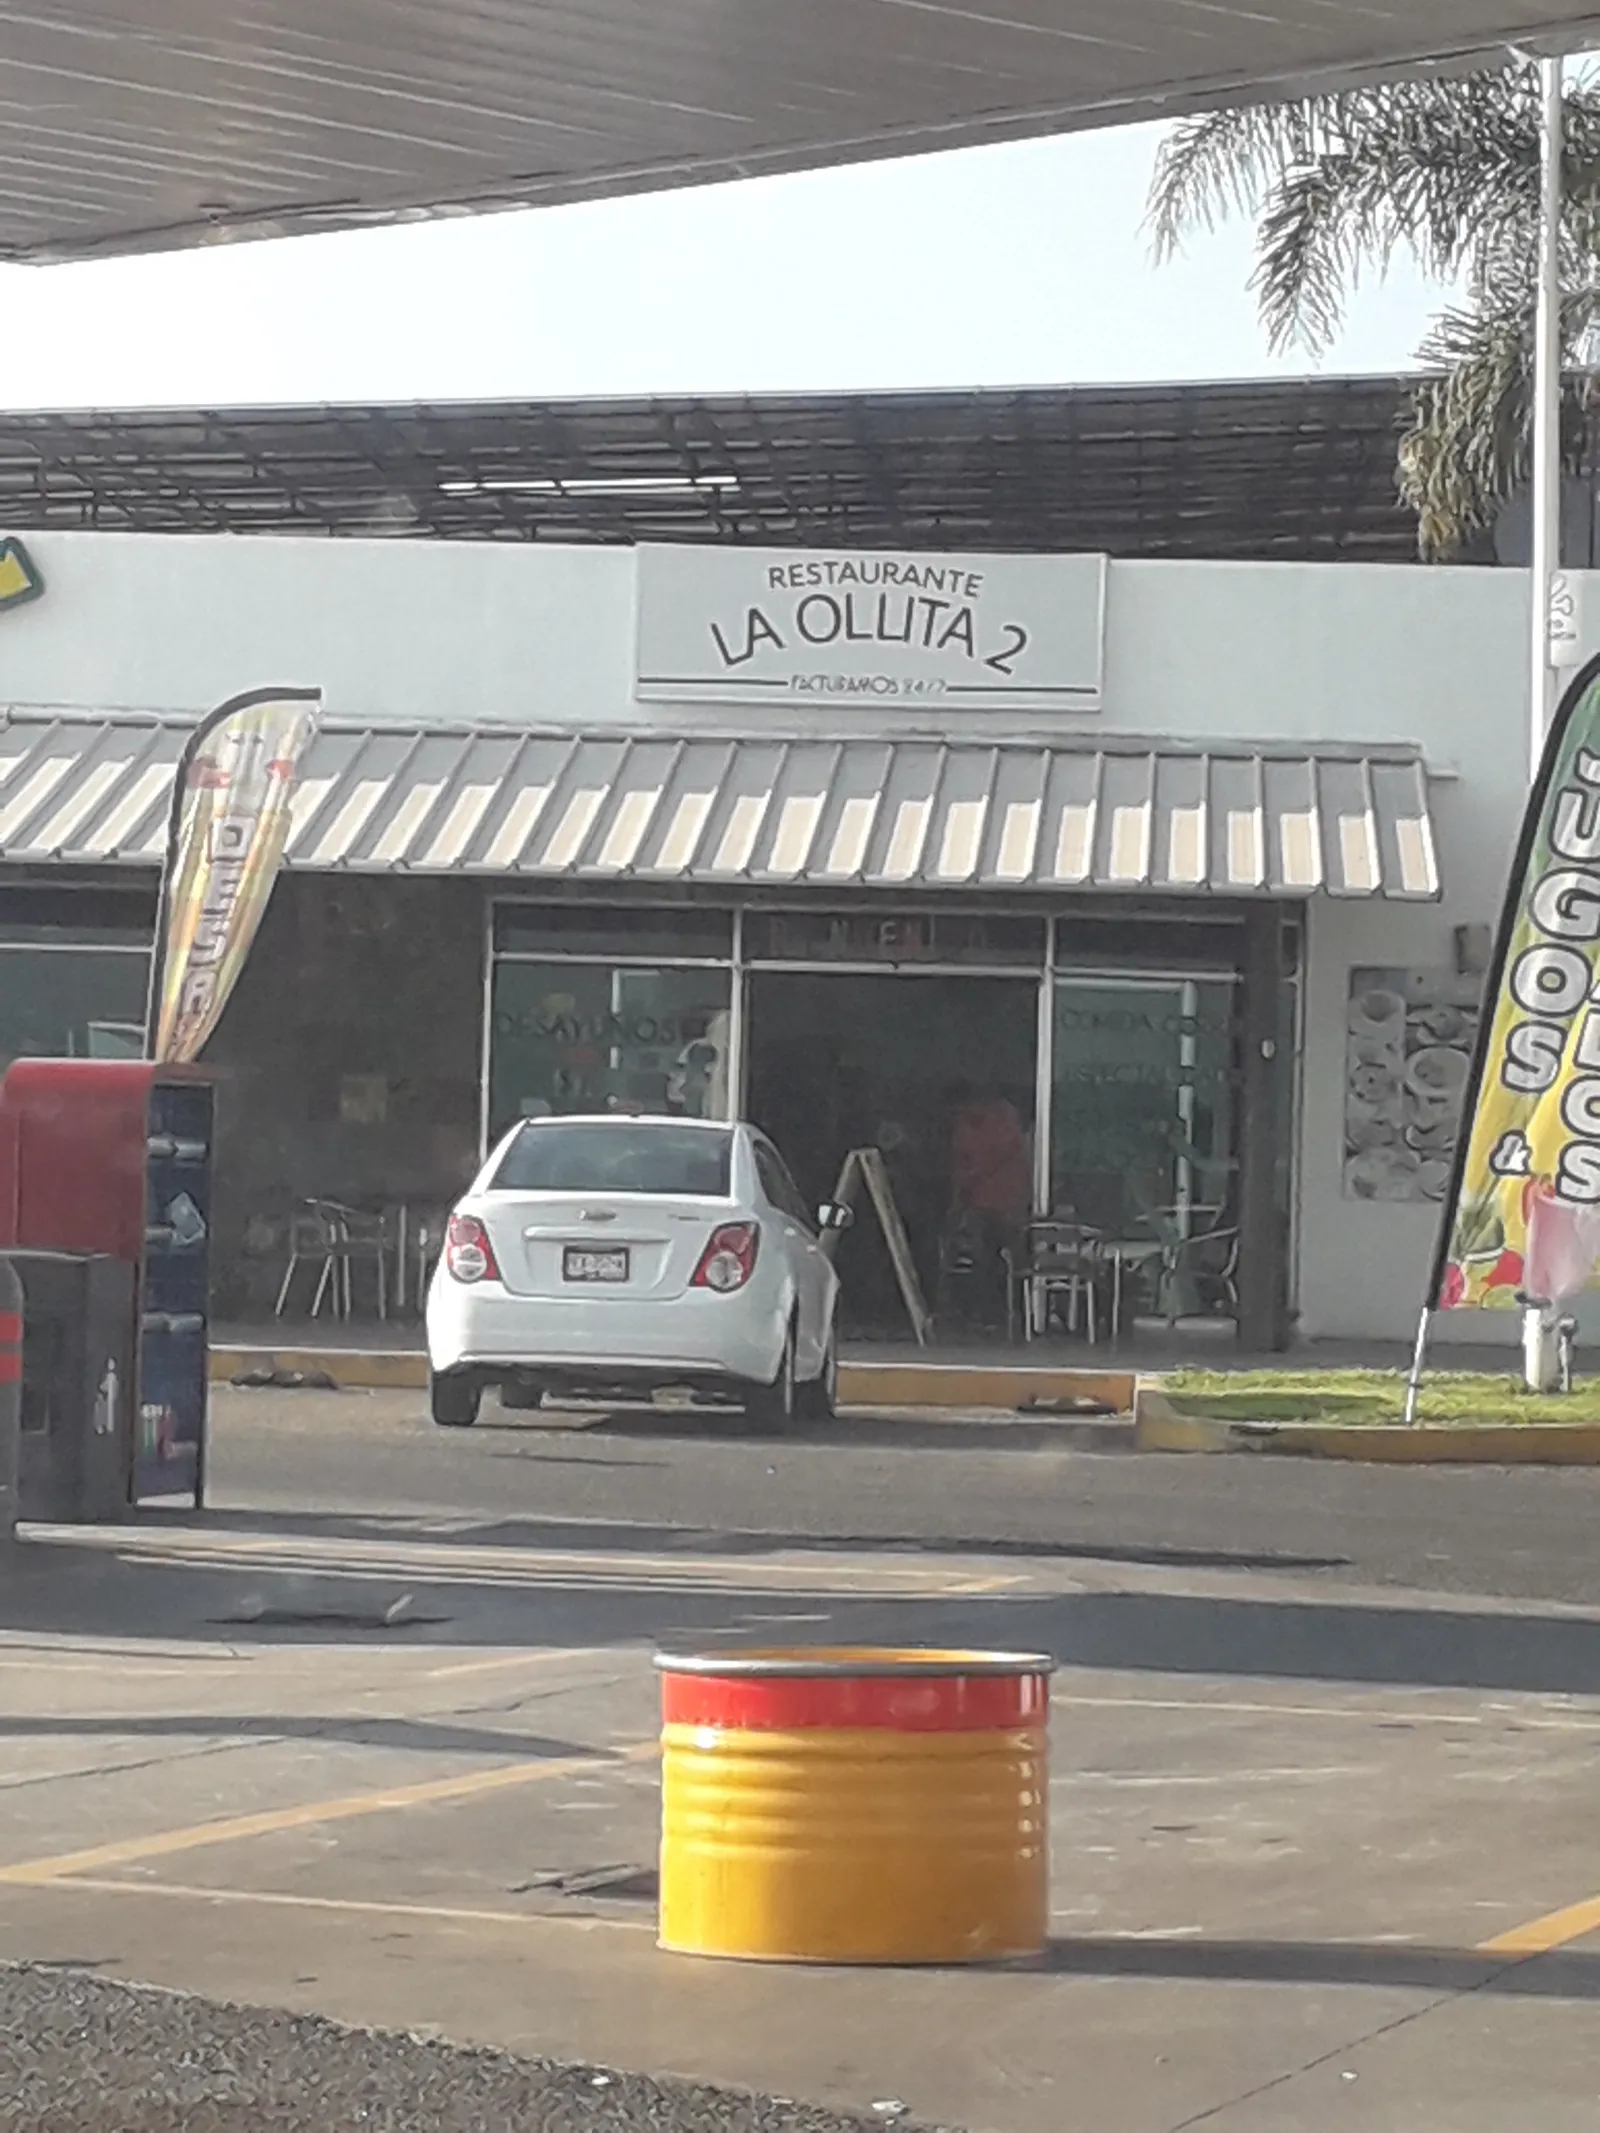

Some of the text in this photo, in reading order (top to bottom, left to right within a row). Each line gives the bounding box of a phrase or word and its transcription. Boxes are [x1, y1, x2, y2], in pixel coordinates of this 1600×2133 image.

[768, 561, 984, 598] RESTAURANTE
[711, 592, 1028, 675] LA OLLITA 2
